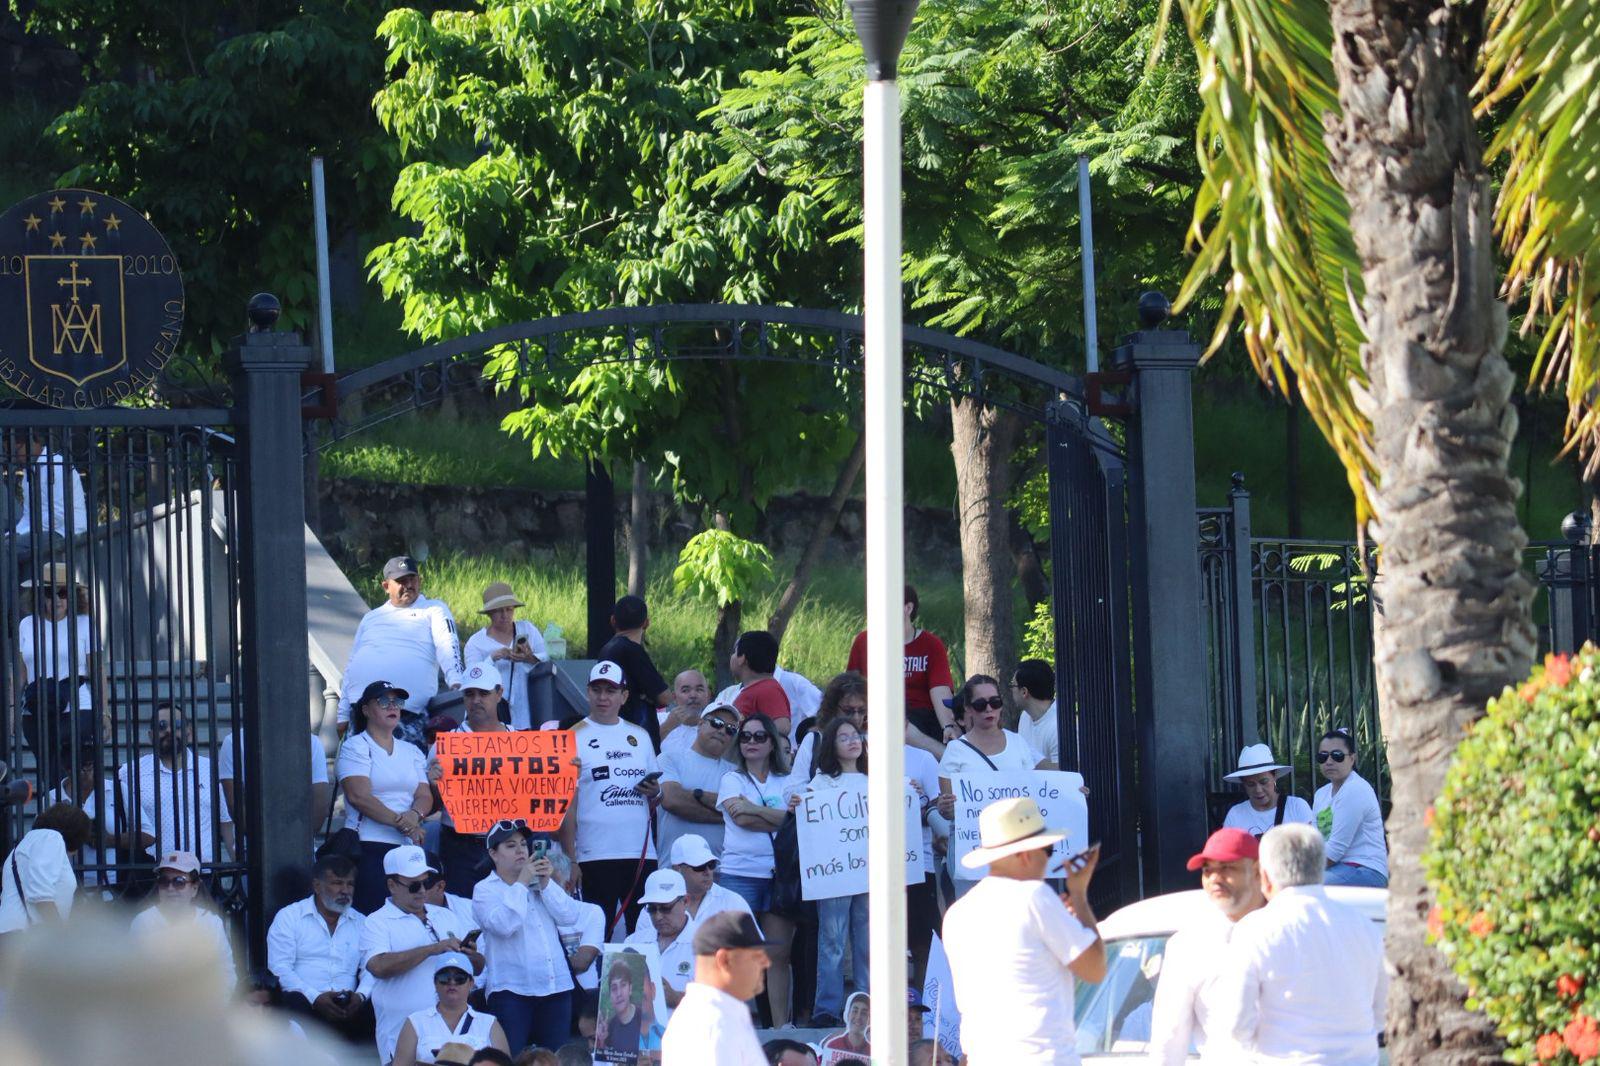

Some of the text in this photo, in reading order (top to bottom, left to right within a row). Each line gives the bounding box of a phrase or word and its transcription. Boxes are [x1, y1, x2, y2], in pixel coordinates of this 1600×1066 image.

[124, 255, 175, 276] 2010
[73, 299, 184, 409] GUADALUPANO
[452, 756, 560, 776] HARTOS
[613, 767, 646, 779] Coppe
[437, 775, 575, 797] DE TANTA VIOLENCIA
[959, 779, 1060, 803] No somos de
[446, 798, 569, 816] QUEREMOS PAZ
[804, 795, 834, 823] En
[839, 825, 869, 843] som
[806, 852, 867, 879] más los
